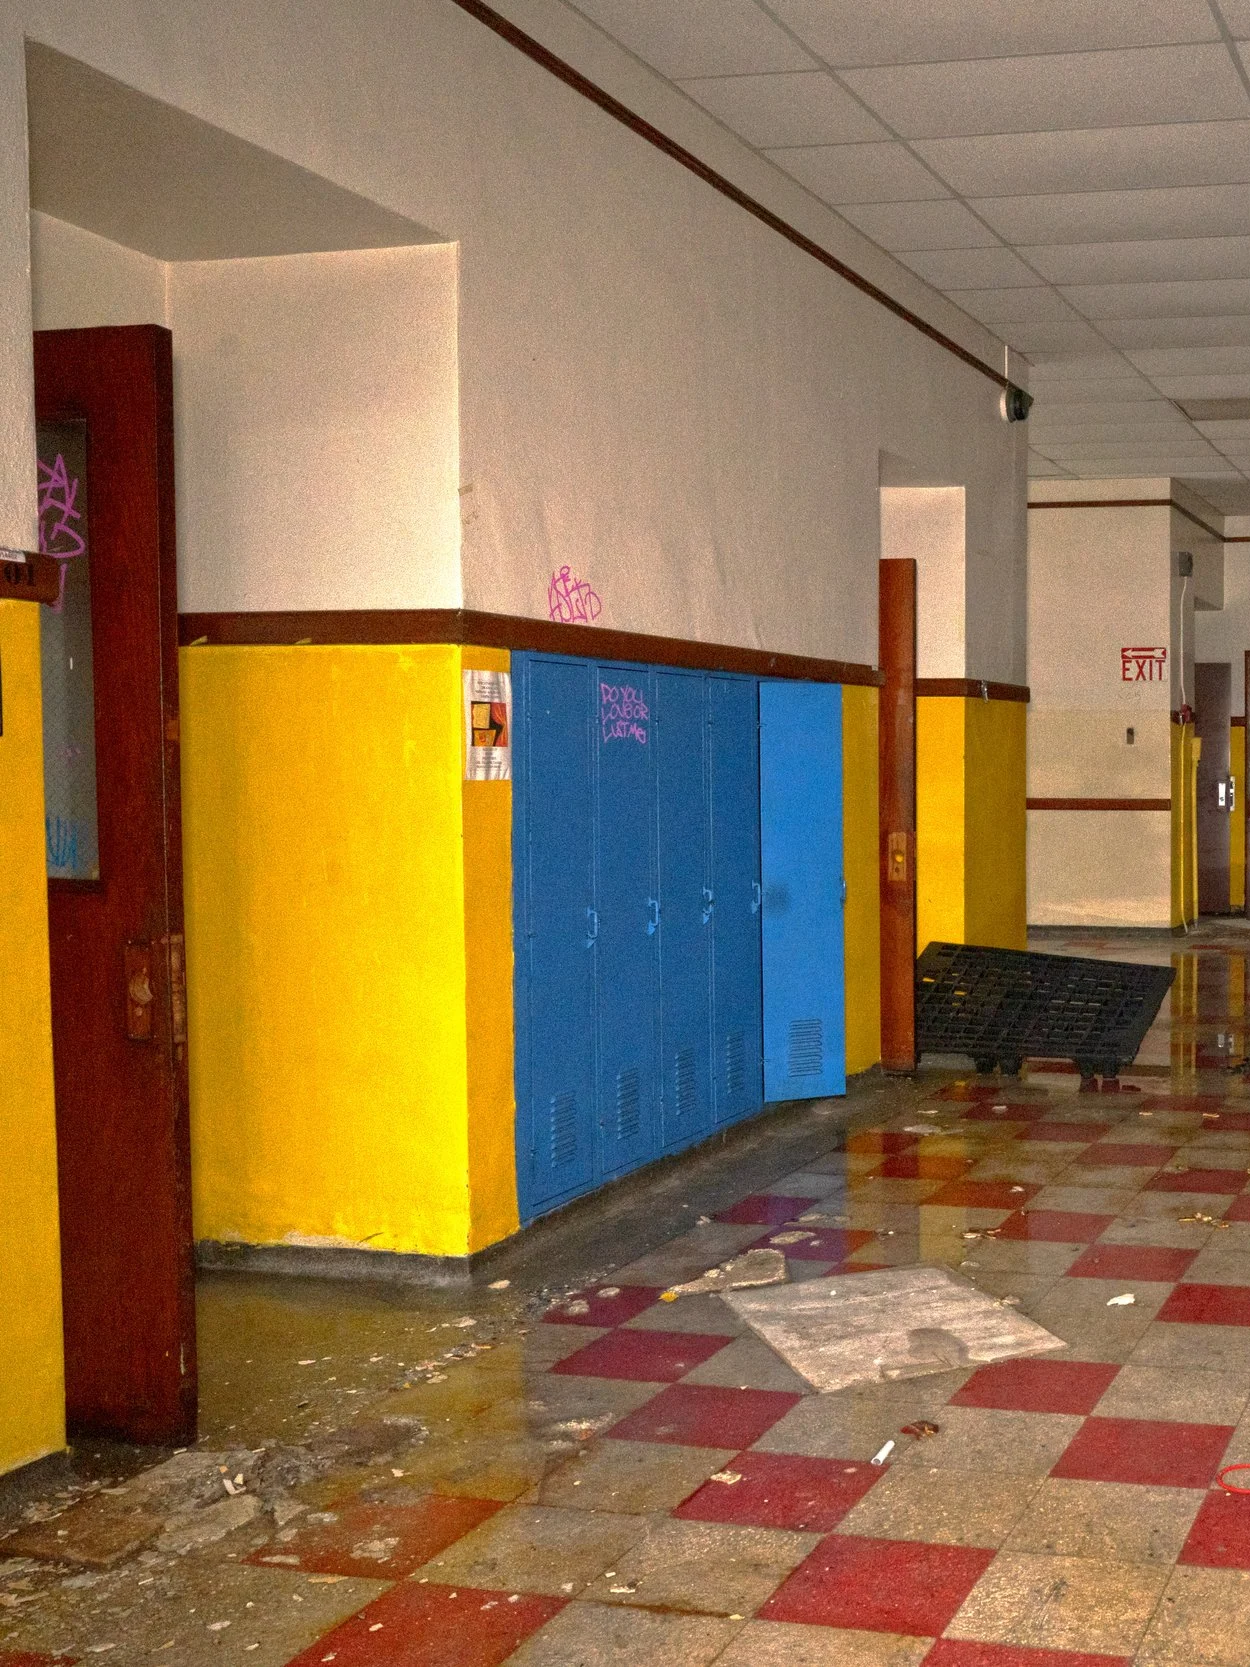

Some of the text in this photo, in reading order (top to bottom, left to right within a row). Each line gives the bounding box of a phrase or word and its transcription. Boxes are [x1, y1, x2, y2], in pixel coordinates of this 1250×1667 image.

[1121, 659, 1166, 681] EXIT
[600, 682, 643, 704] DO YOU
